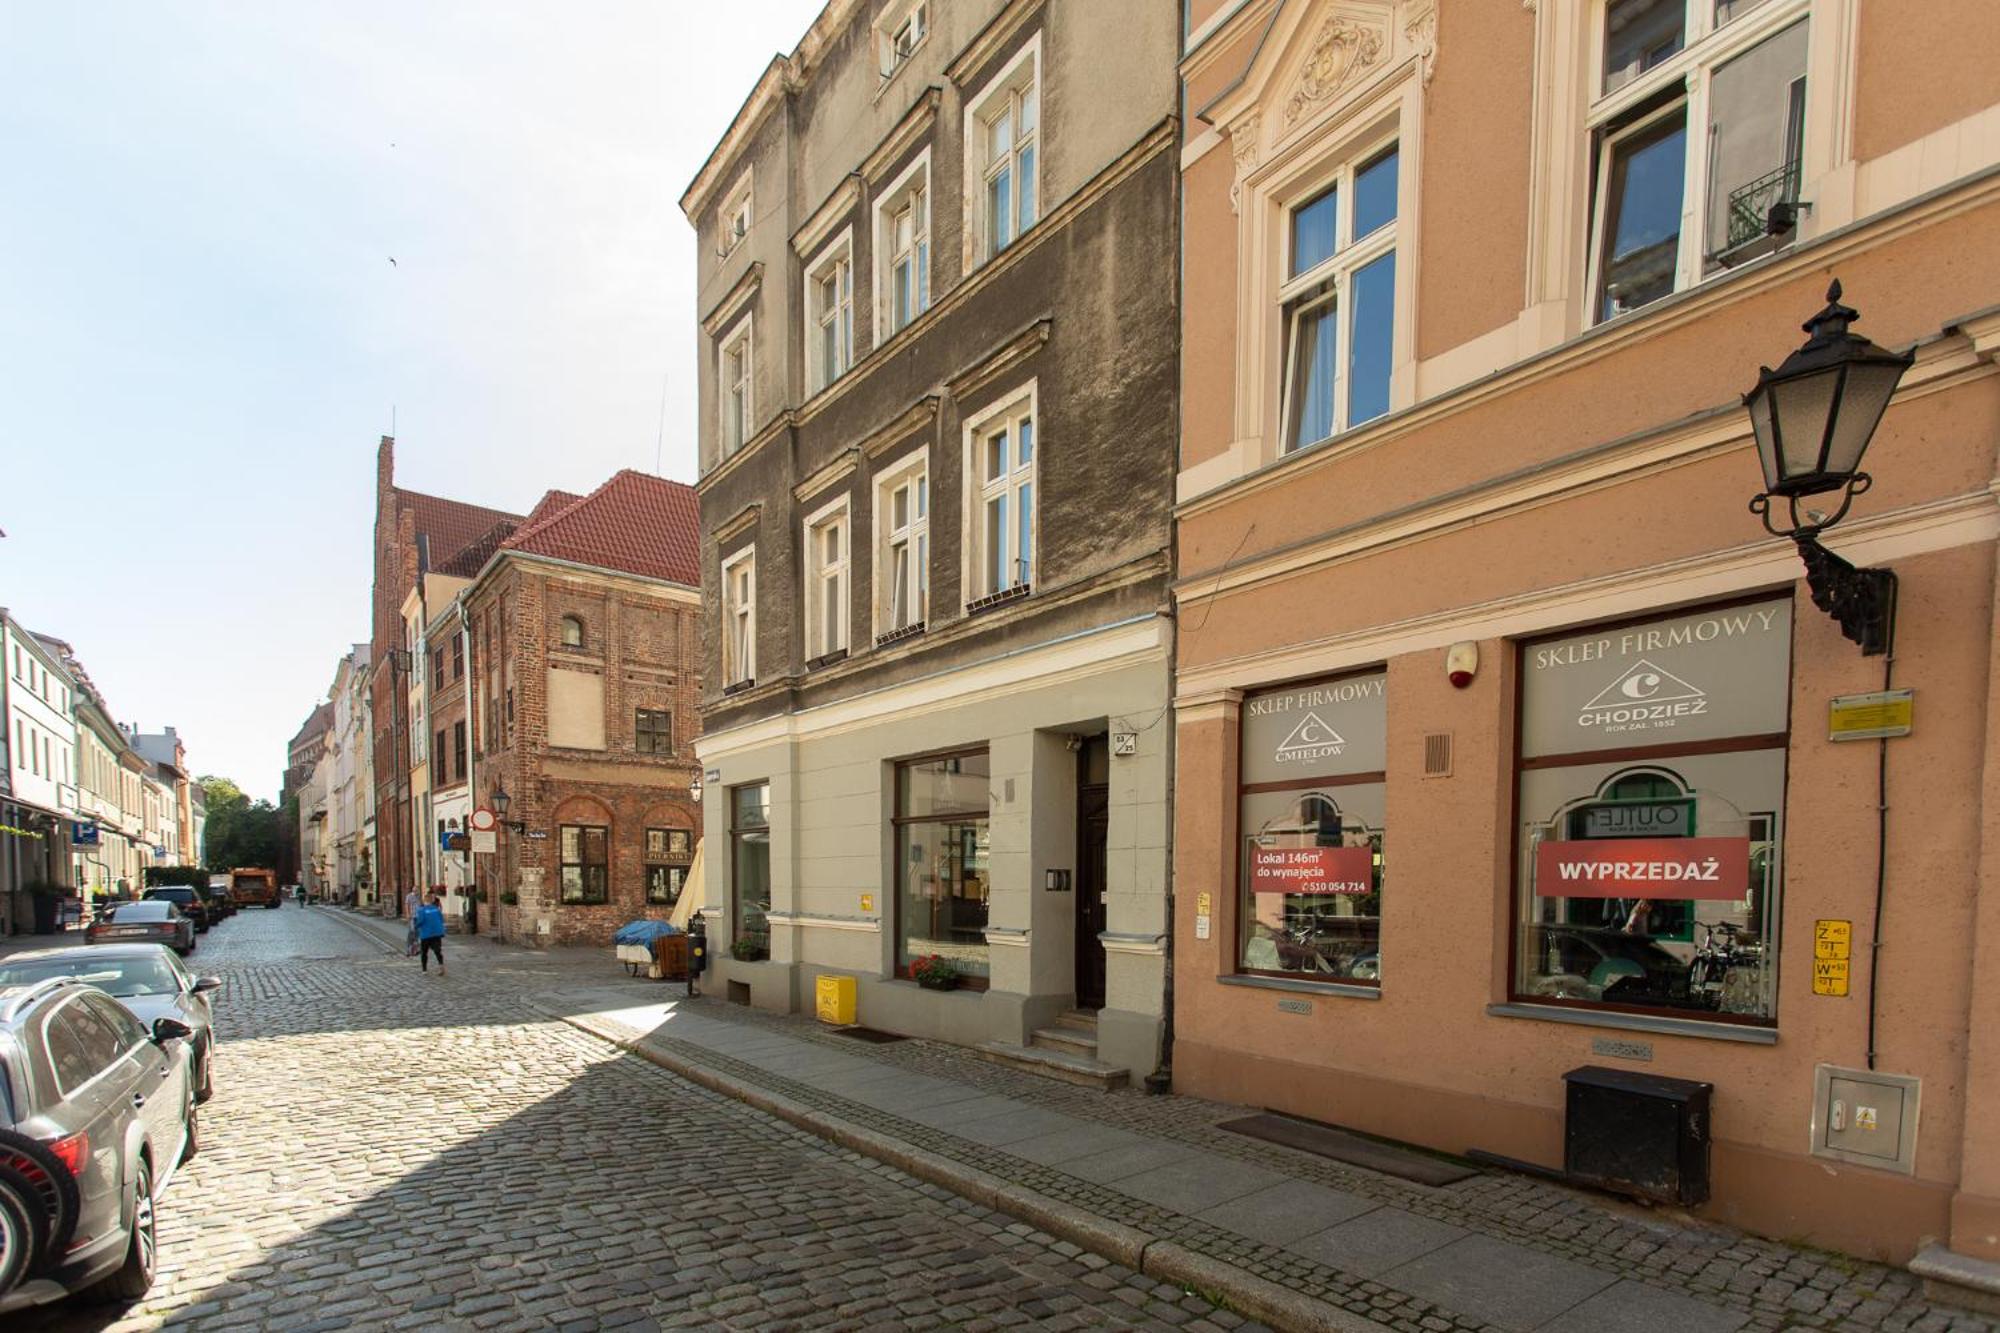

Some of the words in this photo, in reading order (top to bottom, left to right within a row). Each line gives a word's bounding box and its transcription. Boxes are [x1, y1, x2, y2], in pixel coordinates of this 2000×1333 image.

[1536, 638, 1611, 670] SKLEP
[1621, 608, 1777, 655] FIRMOWY
[1621, 672, 1661, 699] C
[1249, 696, 1294, 717] SKLEP
[1298, 679, 1386, 709] FIRMOWY
[1578, 698, 1708, 726] CHODZIEŻ
[1257, 852, 1285, 864] Lokal
[1257, 866, 1270, 877] do
[1272, 866, 1324, 879] wynajęcia
[1558, 857, 1720, 881] WYPRZEDAŻ
[1310, 882, 1327, 891] 510
[1328, 882, 1346, 891] 054
[1348, 882, 1365, 891] 714
[1818, 927, 1829, 939] Z
[1816, 964, 1830, 975] W
